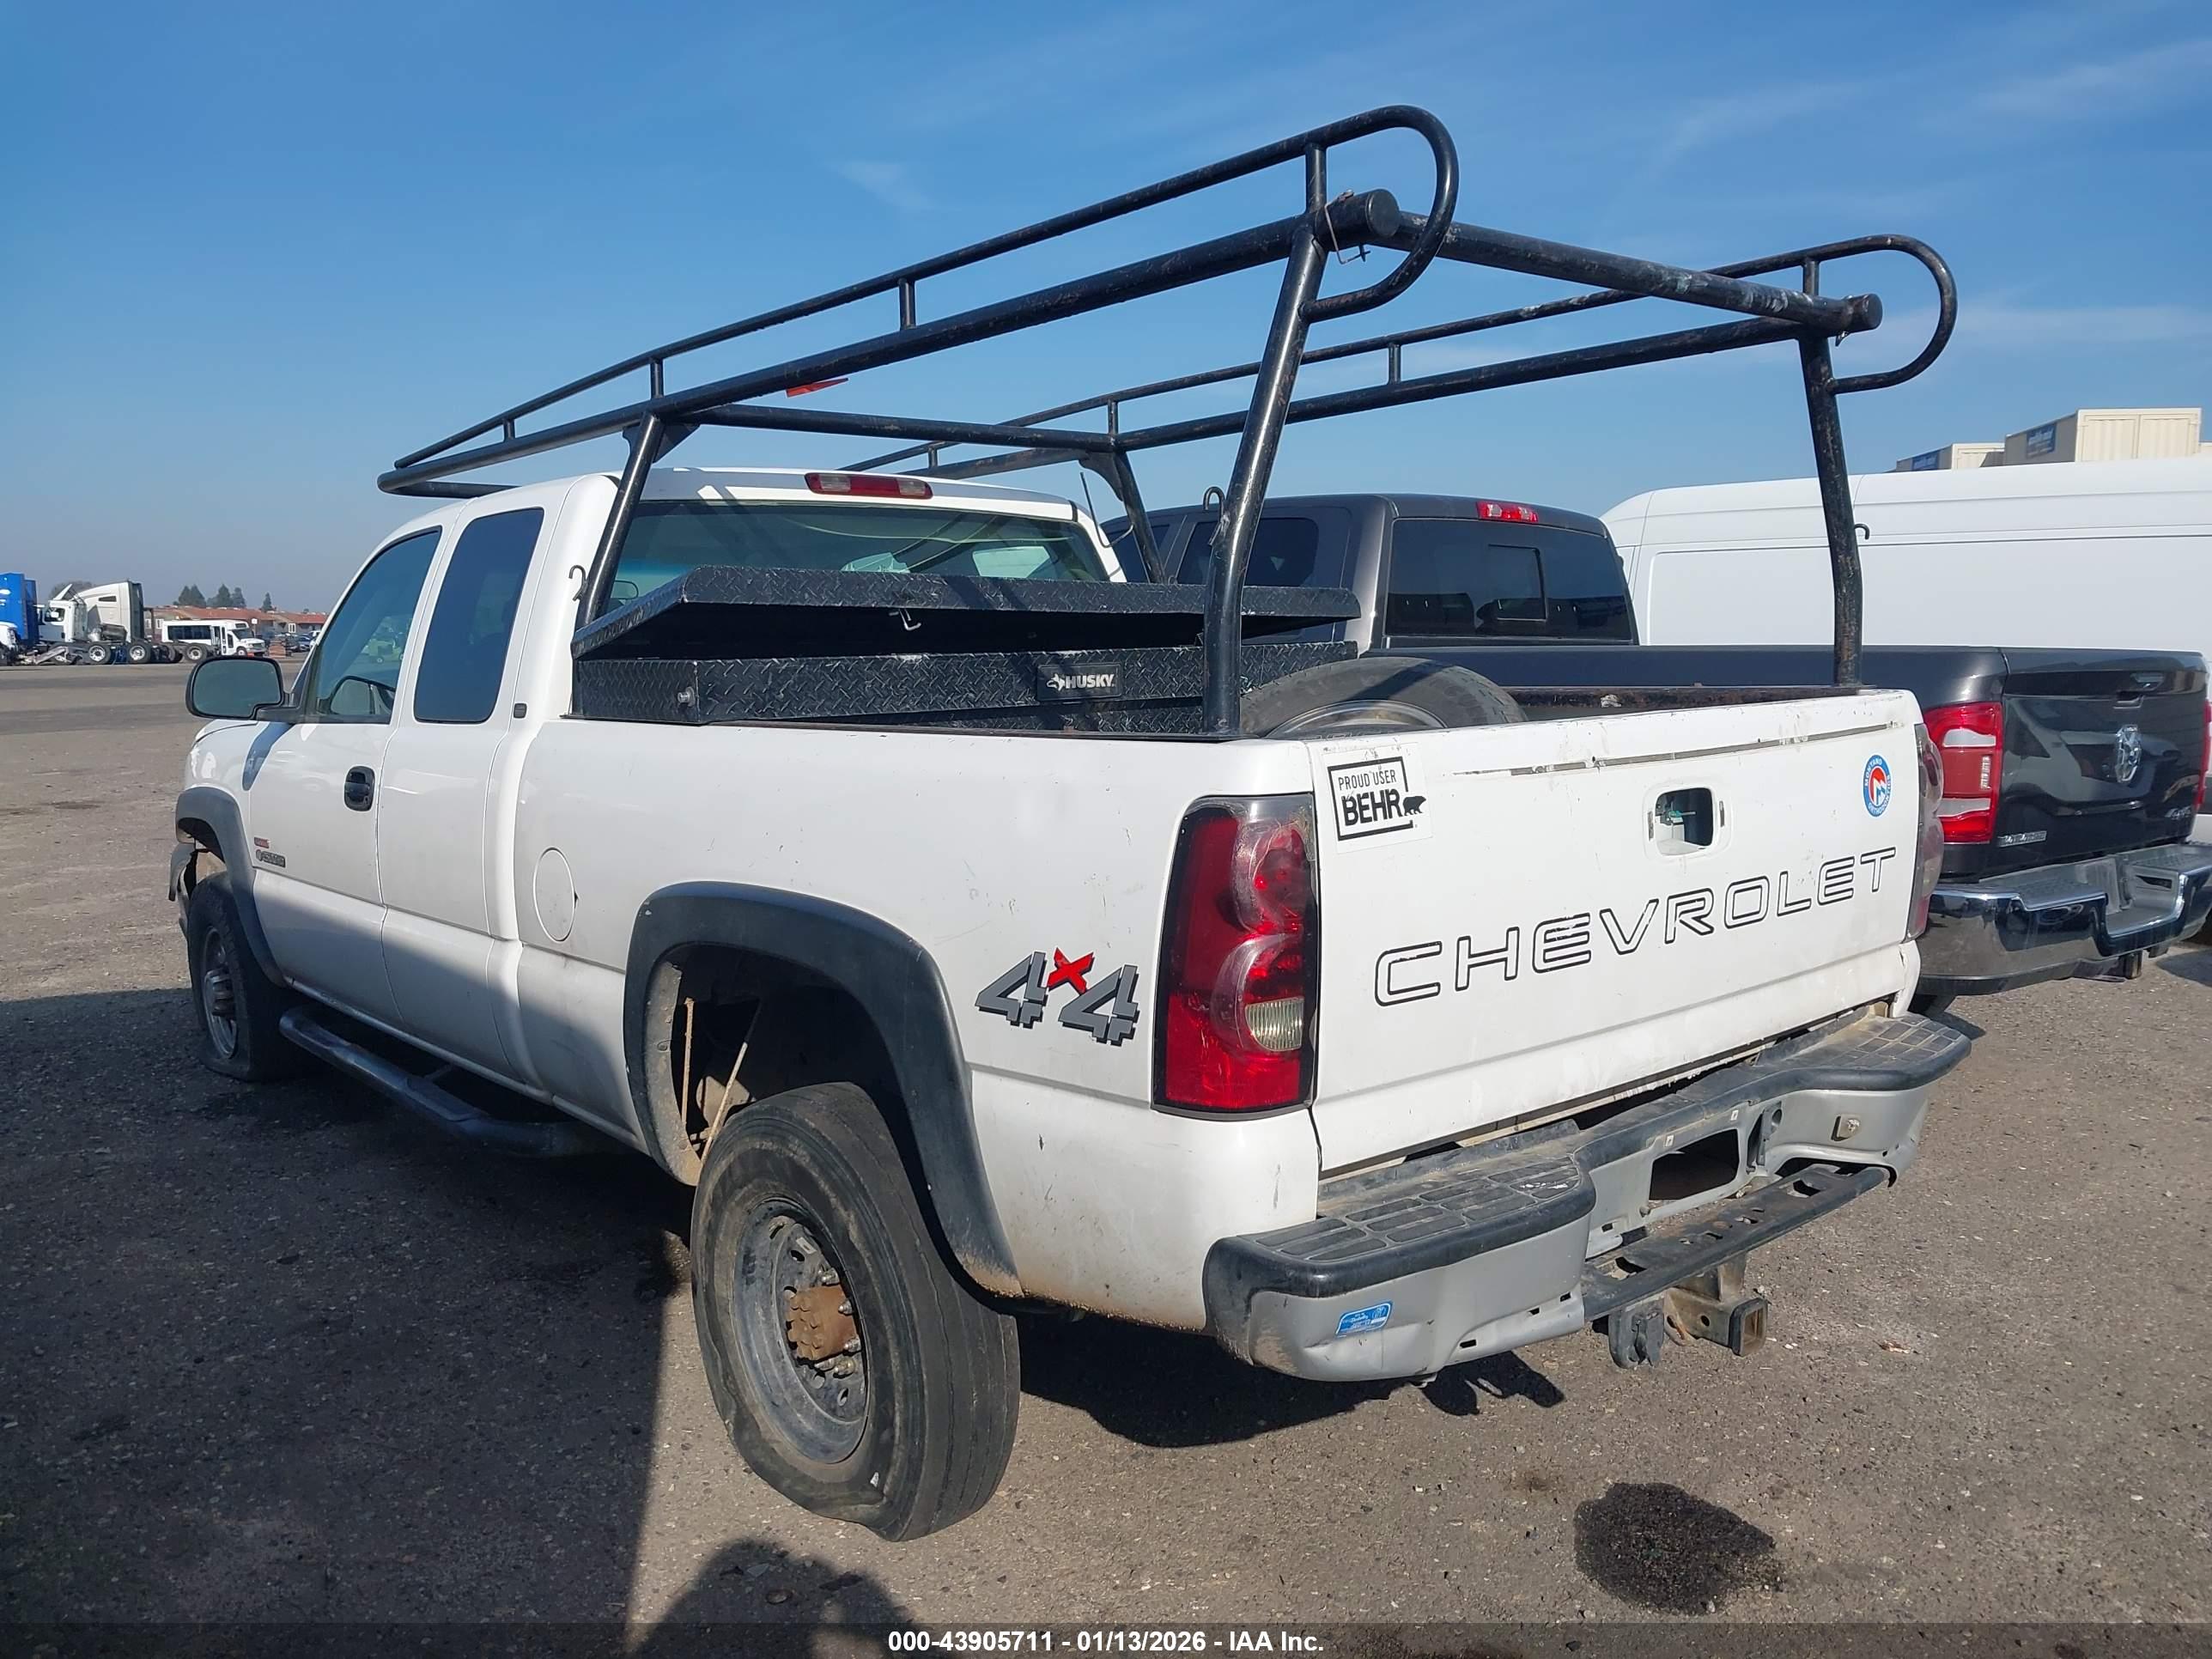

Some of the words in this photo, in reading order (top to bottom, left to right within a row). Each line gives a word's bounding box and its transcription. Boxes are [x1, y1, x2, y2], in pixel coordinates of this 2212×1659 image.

[1065, 673, 1115, 689] HUSKY
[1338, 773, 1370, 790] PROUD
[1373, 769, 1396, 785] USER
[1341, 788, 1403, 826] BEHR
[1375, 847, 1897, 1006] CHEVROLET
